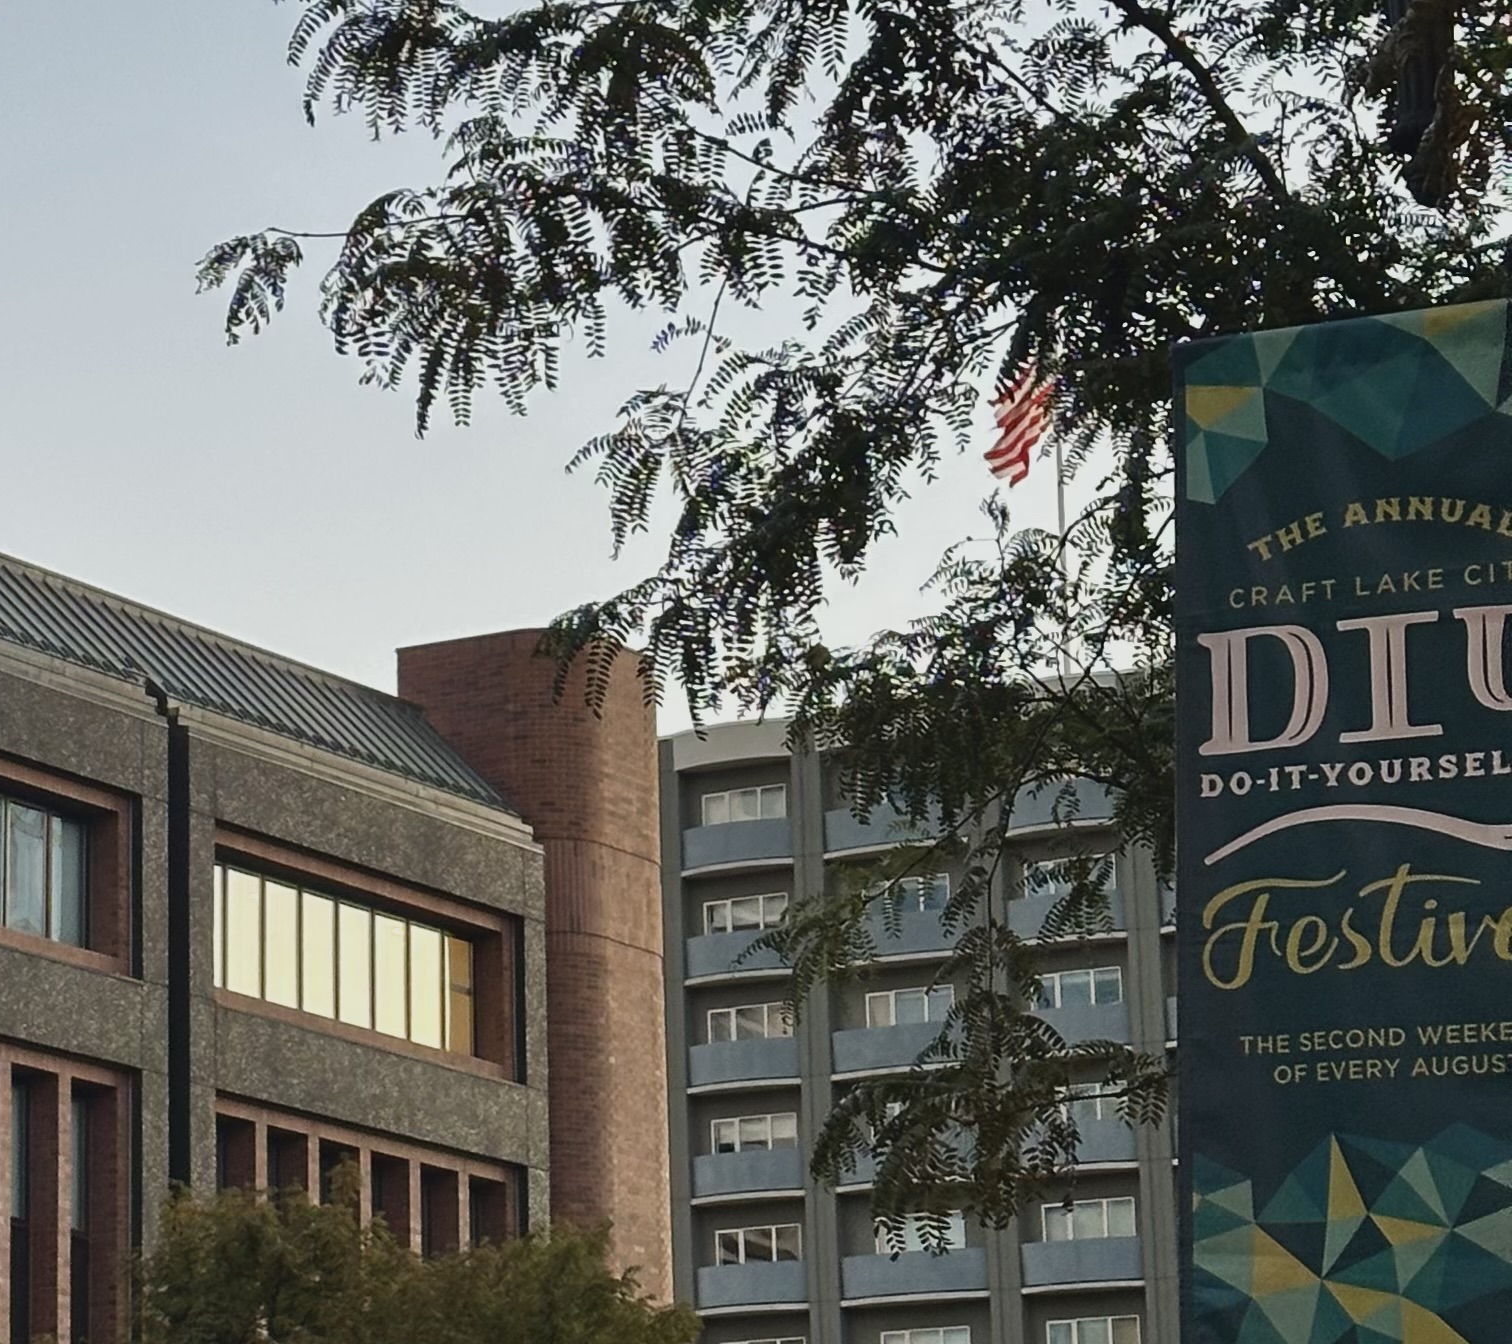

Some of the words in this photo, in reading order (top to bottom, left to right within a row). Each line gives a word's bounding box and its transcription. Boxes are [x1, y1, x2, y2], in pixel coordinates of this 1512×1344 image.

[1246, 511, 1327, 561] THE
[1343, 496, 1512, 538] ANNUAL
[1229, 579, 1336, 608] CRAFT
[1355, 568, 1444, 596] LAKE
[1240, 1034, 1290, 1055] THE
[1299, 1027, 1406, 1052] SECOND
[1417, 1021, 1512, 1046] WEEKE
[1274, 1064, 1308, 1084] OF
[1317, 1058, 1401, 1082] EVERY
[1412, 1053, 1512, 1078] AUGUS
